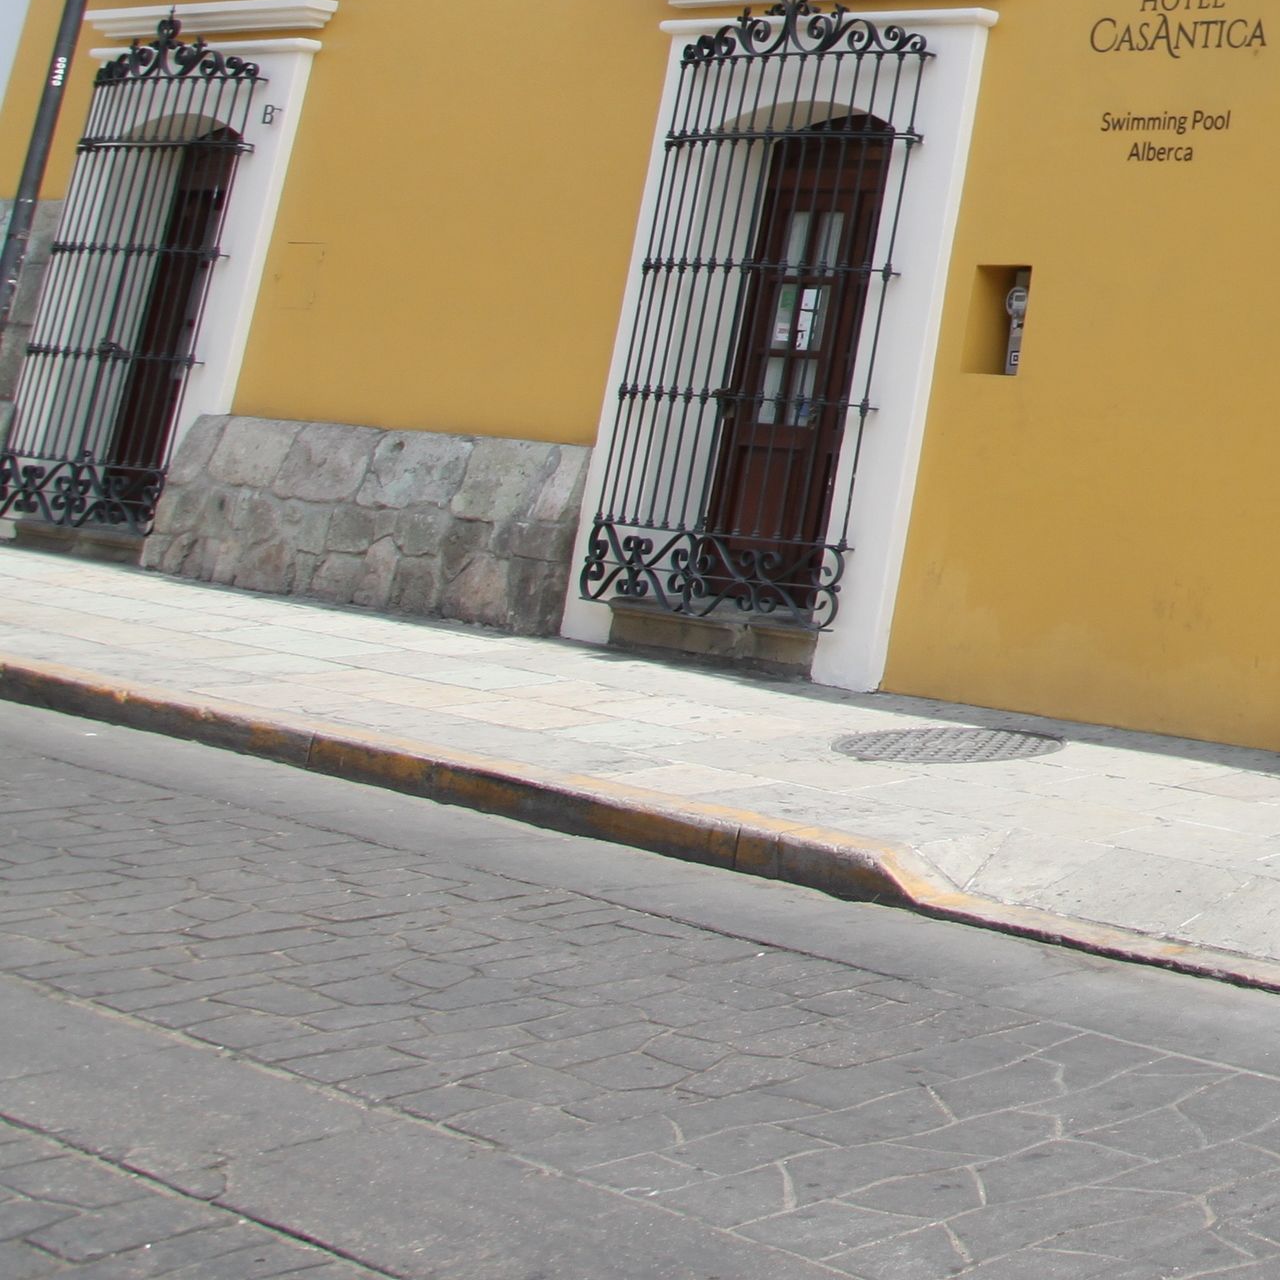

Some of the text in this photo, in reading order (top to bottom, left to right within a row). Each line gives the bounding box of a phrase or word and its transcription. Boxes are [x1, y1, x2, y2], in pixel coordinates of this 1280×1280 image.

[1100, 110, 1231, 135] Swimming Pool
[1127, 141, 1194, 162] Alberca
